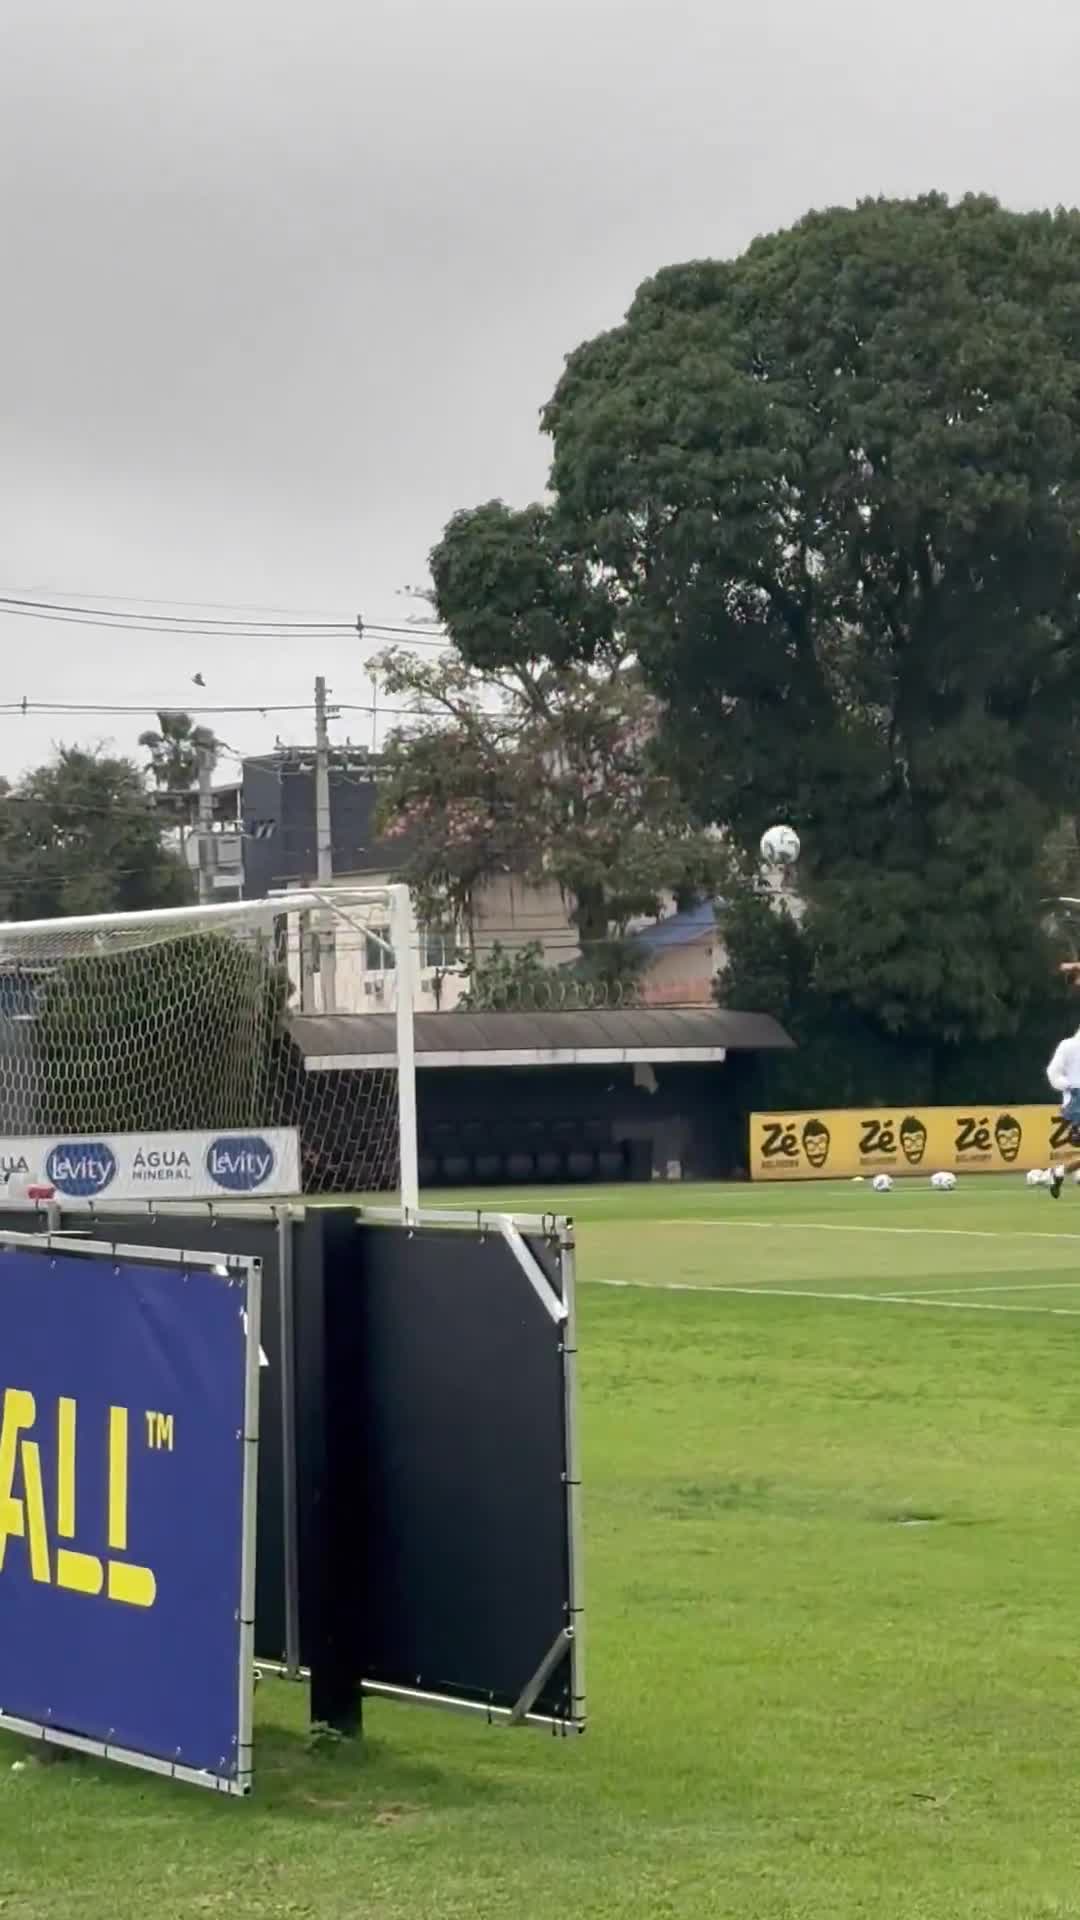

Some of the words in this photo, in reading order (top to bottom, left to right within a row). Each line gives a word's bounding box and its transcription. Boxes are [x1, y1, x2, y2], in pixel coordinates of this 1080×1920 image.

[761, 1122, 800, 1158] Zé
[859, 1119, 897, 1154] Zé
[955, 1117, 992, 1152] Zé
[52, 1156, 112, 1185] Levity
[132, 1147, 191, 1168] ÁGUA
[211, 1149, 270, 1177] Levity
[132, 1167, 192, 1181] MINERAL
